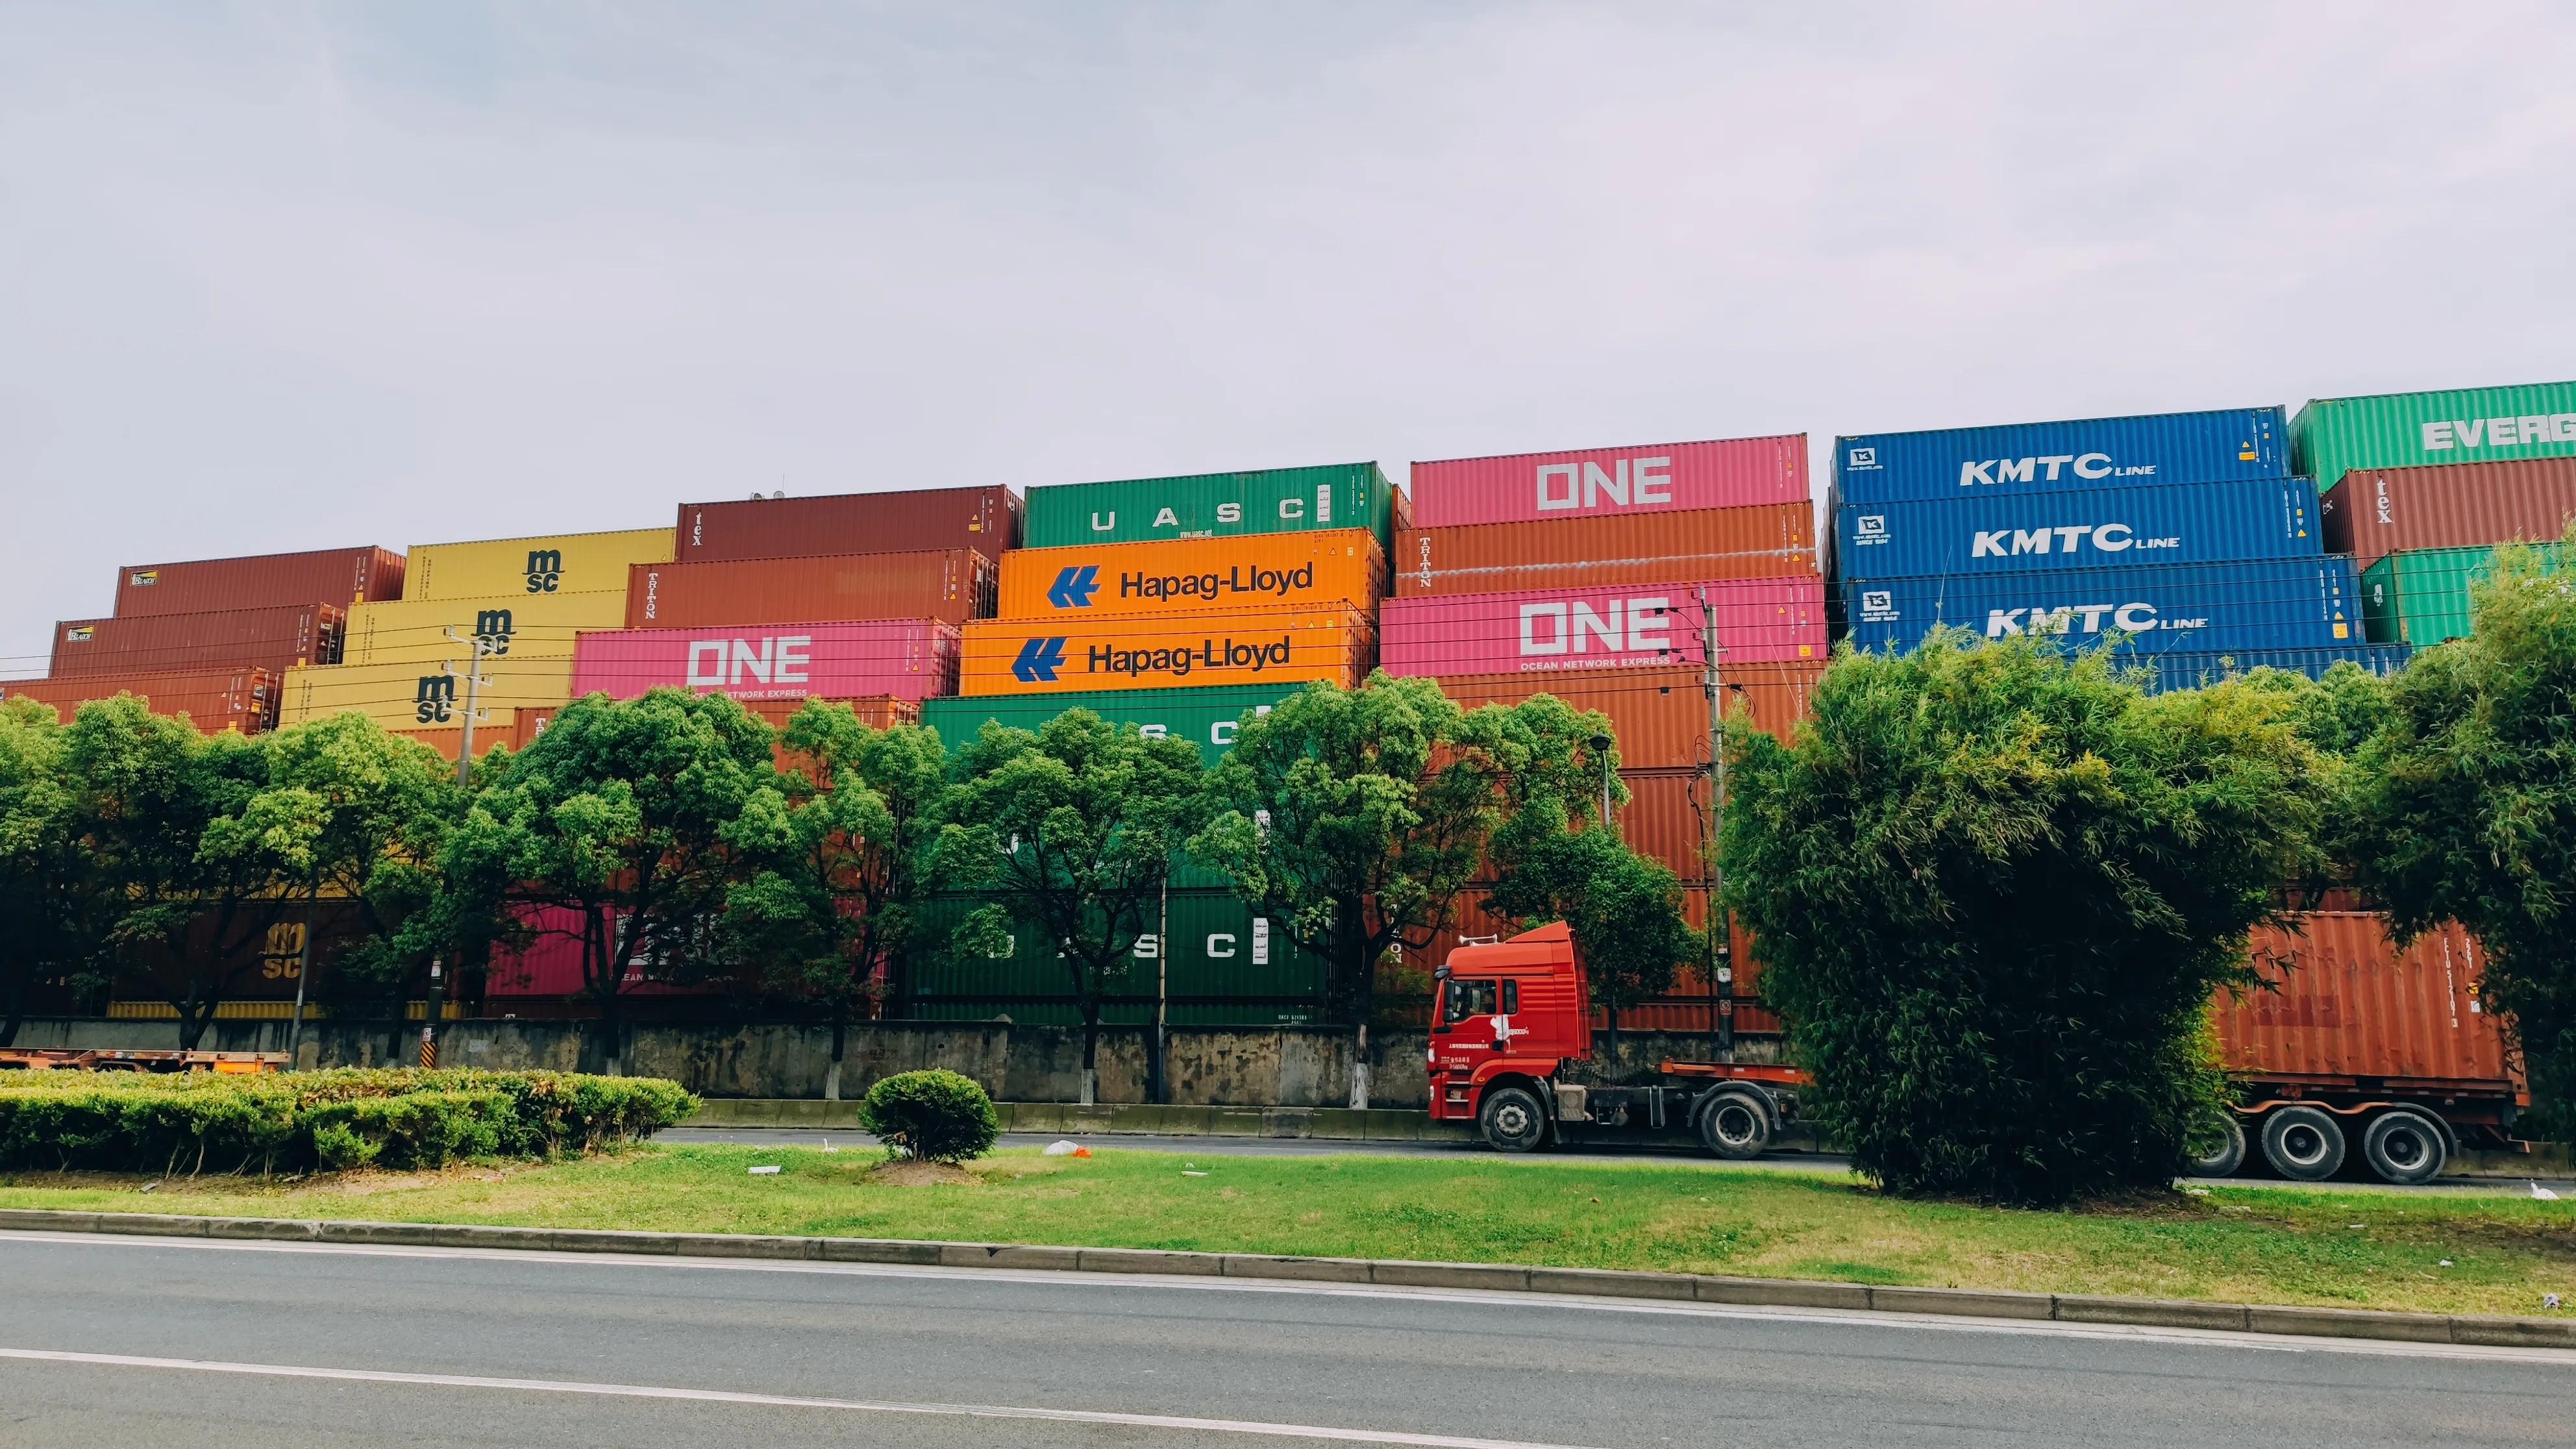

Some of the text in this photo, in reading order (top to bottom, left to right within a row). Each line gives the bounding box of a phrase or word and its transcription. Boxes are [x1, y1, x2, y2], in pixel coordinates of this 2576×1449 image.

[1536, 456, 1672, 511] ONE
[1959, 452, 2157, 486] KMTC LINE
[2377, 478, 2393, 524] tex
[691, 510, 703, 547] tex
[1972, 523, 2181, 558] KMTC LINE
[1121, 561, 1313, 602] Hapag-Lloyd
[1419, 536, 1431, 588] TRITON
[645, 573, 658, 619] TRITON
[1520, 597, 1671, 656] ONE
[1987, 602, 2209, 638] KMTC LINE
[686, 635, 811, 686] ONE
[1088, 635, 1291, 678] Hapag-Lloyd
[1520, 656, 1671, 671] OCEAN NETWORK EXPRESS
[727, 689, 808, 699] ETWORK EXPRESS
[2451, 1018, 2458, 1028] 3
